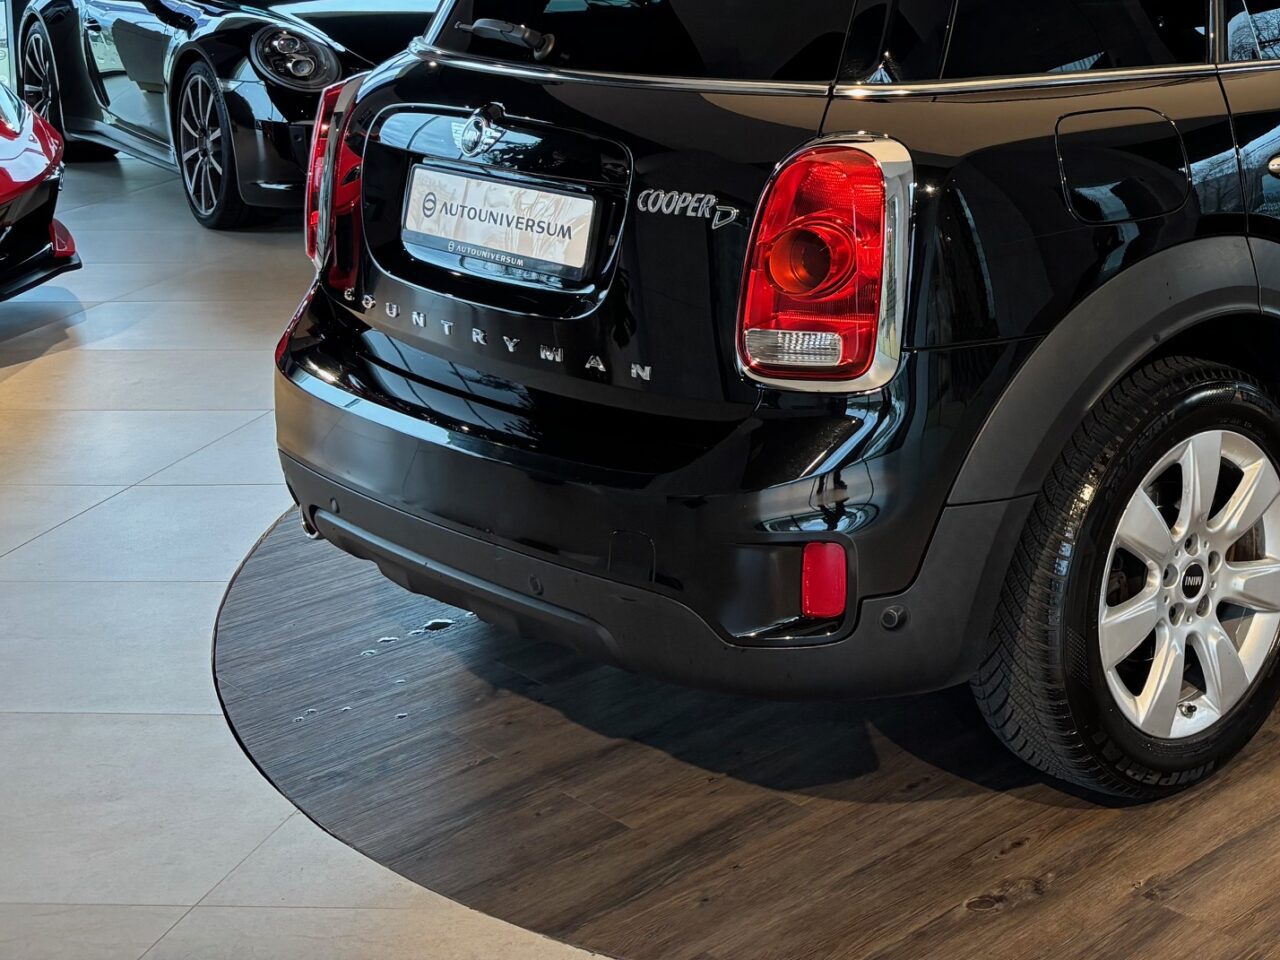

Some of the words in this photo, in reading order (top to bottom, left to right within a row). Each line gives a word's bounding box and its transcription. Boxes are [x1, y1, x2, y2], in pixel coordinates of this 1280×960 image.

[637, 189, 716, 220] COOPER
[439, 201, 573, 240] AUTOUNIVERSUM
[455, 244, 525, 267] AUTOUNIVERSUM
[343, 286, 653, 381] COUNTRYMAN
[1184, 575, 1203, 586] MINI
